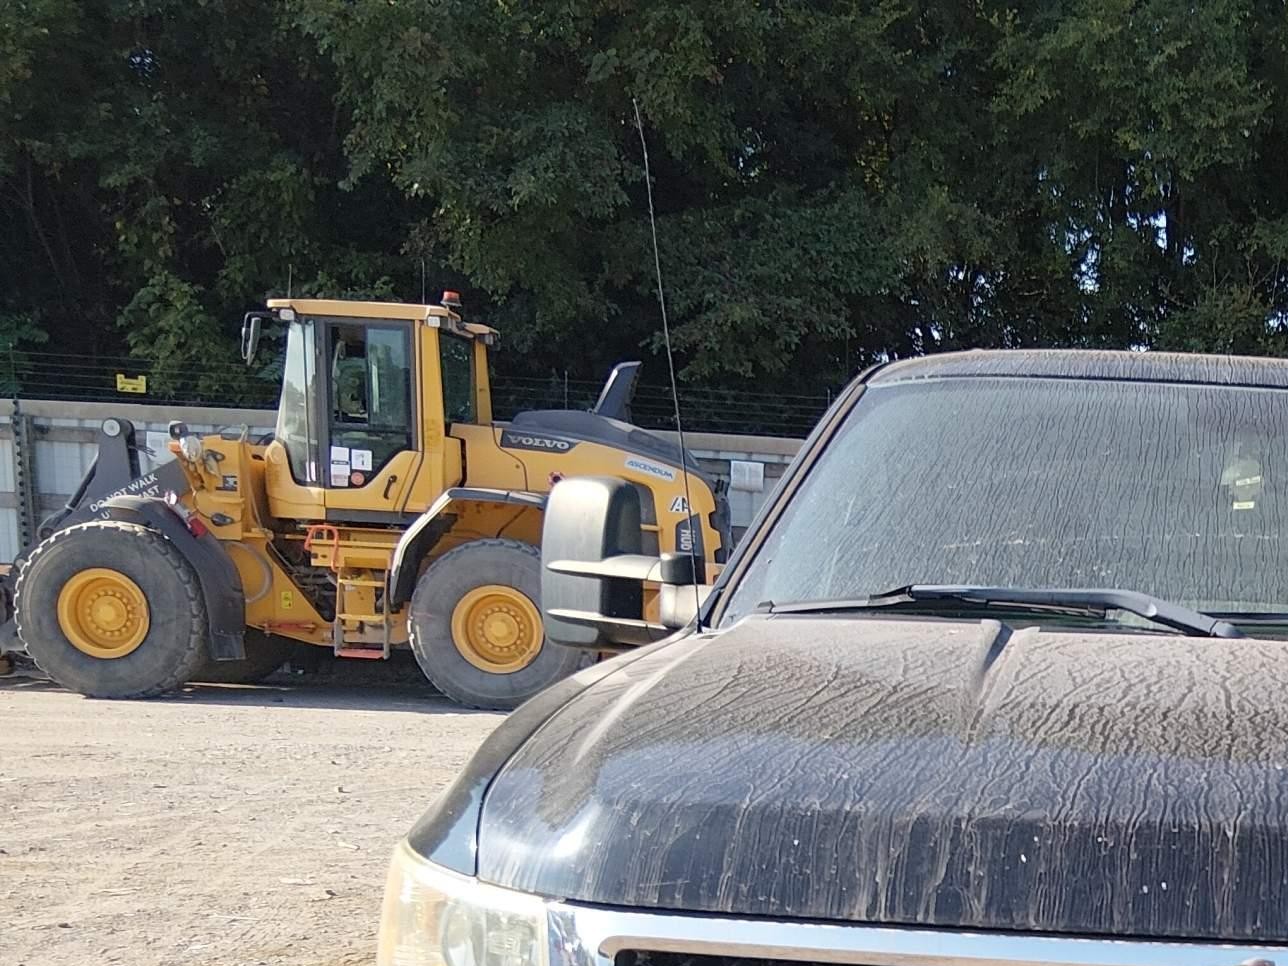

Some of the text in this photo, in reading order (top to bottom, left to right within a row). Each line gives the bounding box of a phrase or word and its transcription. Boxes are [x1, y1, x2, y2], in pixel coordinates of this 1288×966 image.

[506, 434, 570, 449] VOLVO
[627, 460, 673, 479] ASCENDUM
[128, 473, 158, 492] WALK
